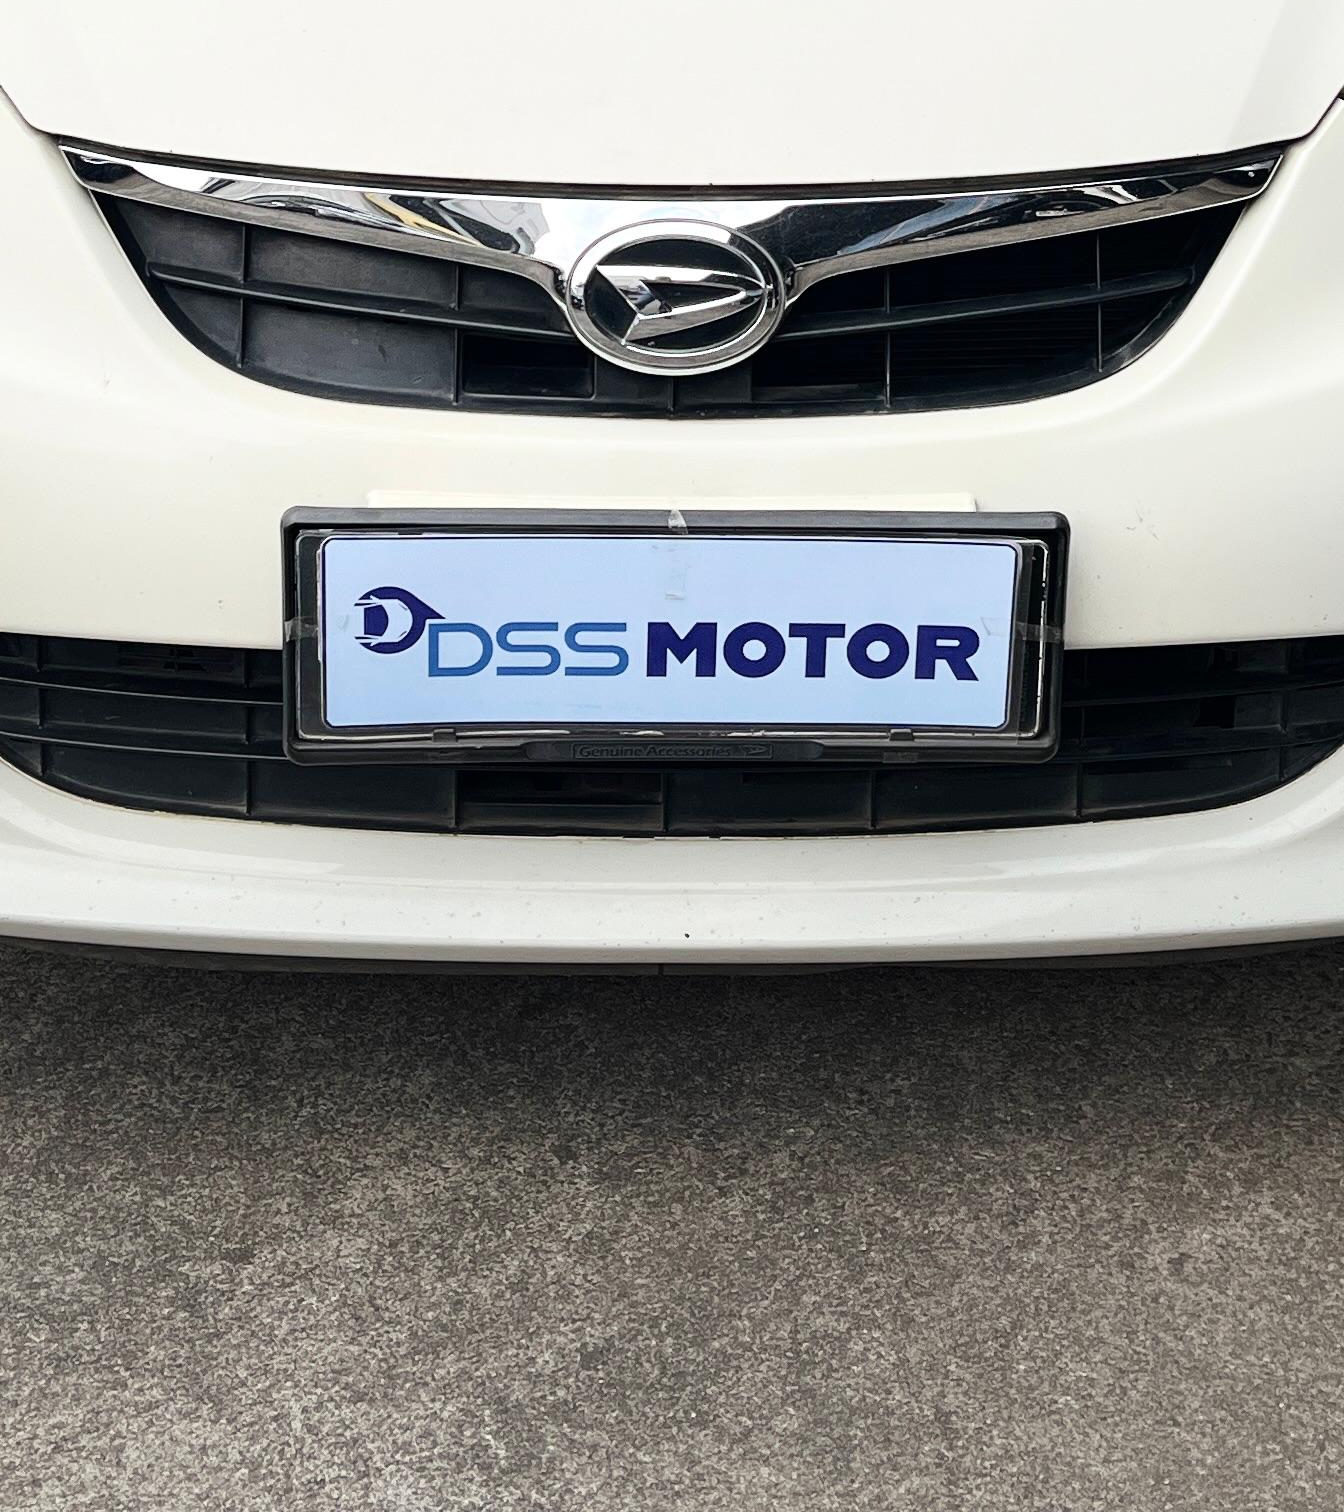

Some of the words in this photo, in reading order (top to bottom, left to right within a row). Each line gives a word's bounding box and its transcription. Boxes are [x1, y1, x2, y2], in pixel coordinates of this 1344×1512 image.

[428, 621, 630, 678] DSS
[646, 621, 980, 682] MOTOR
[578, 744, 643, 758] Genuine
[645, 744, 732, 758] Accessories
